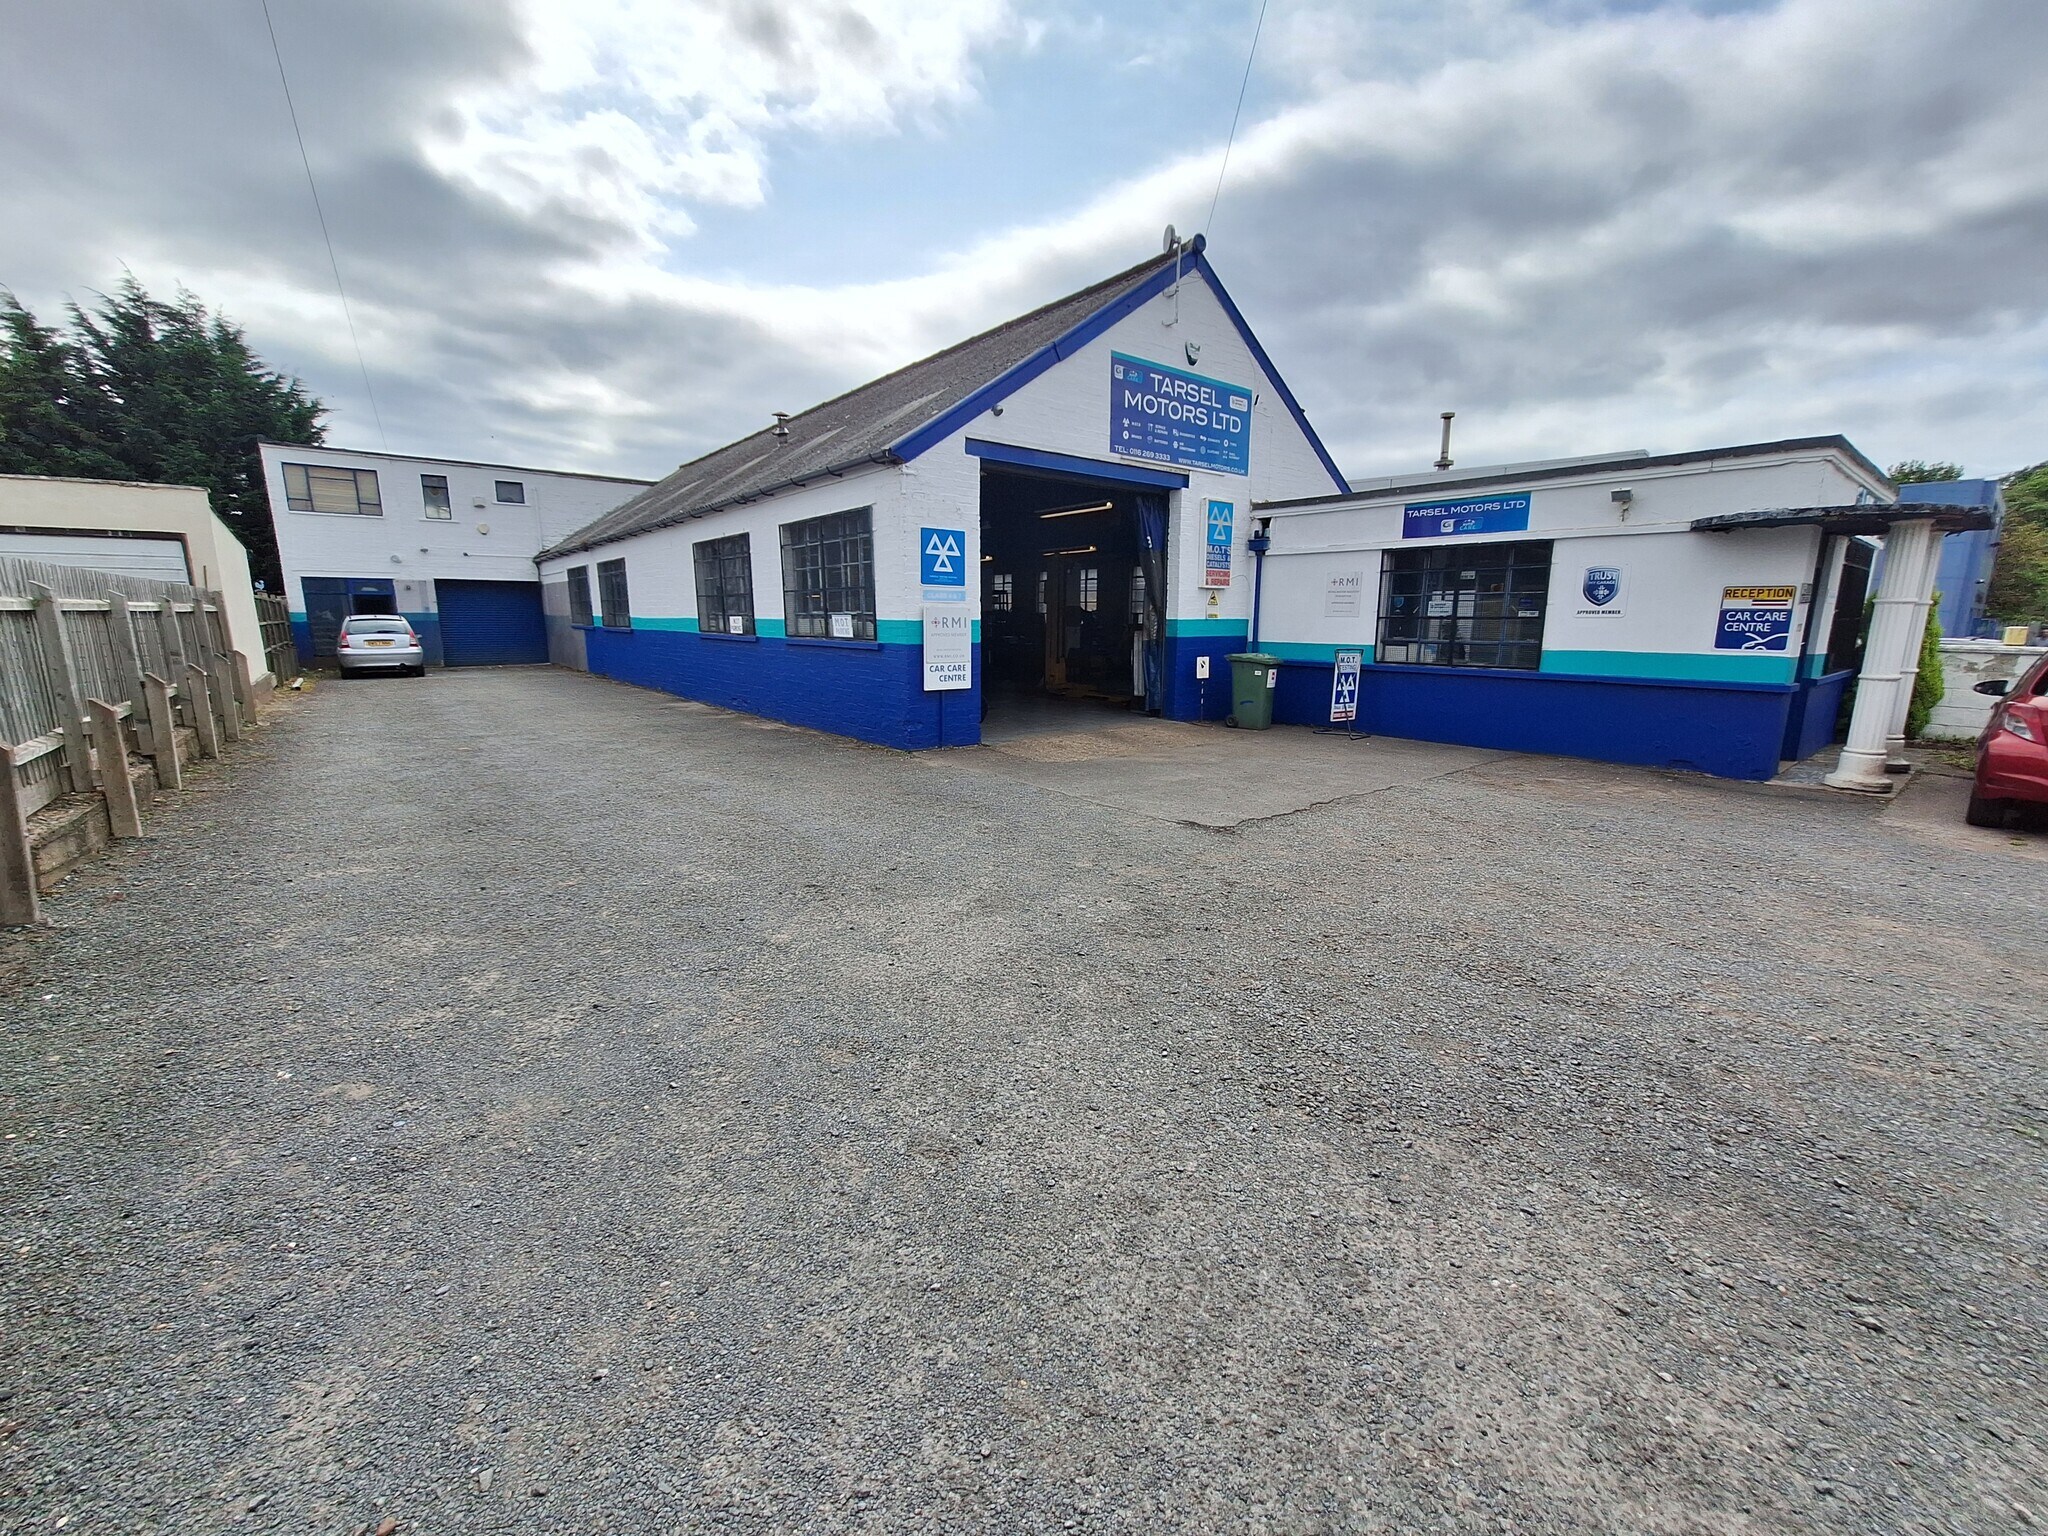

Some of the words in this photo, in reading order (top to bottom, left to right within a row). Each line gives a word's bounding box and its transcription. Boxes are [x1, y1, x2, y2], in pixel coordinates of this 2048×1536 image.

[1150, 373, 1222, 409] TARSEL
[1124, 389, 1208, 426] MOTORS
[1212, 411, 1242, 433] LTD
[1114, 445, 1128, 454] TEL:
[1130, 448, 1142, 456] 0116
[1142, 450, 1154, 458] 269
[1155, 453, 1171, 461] 3333
[1407, 508, 1449, 518] TARSEL
[1450, 502, 1501, 515] MOTORS
[1503, 500, 1526, 510] LTD
[1589, 571, 1617, 580] TRUST
[1339, 577, 1359, 586] RMI
[1724, 588, 1794, 598] RECEPTION
[1726, 611, 1751, 621] CAR
[1753, 611, 1788, 621] CARE
[942, 617, 967, 628] RMI
[1724, 622, 1772, 632] CENTRE
[947, 664, 967, 672] CARE
[938, 674, 967, 682] CENTRE
